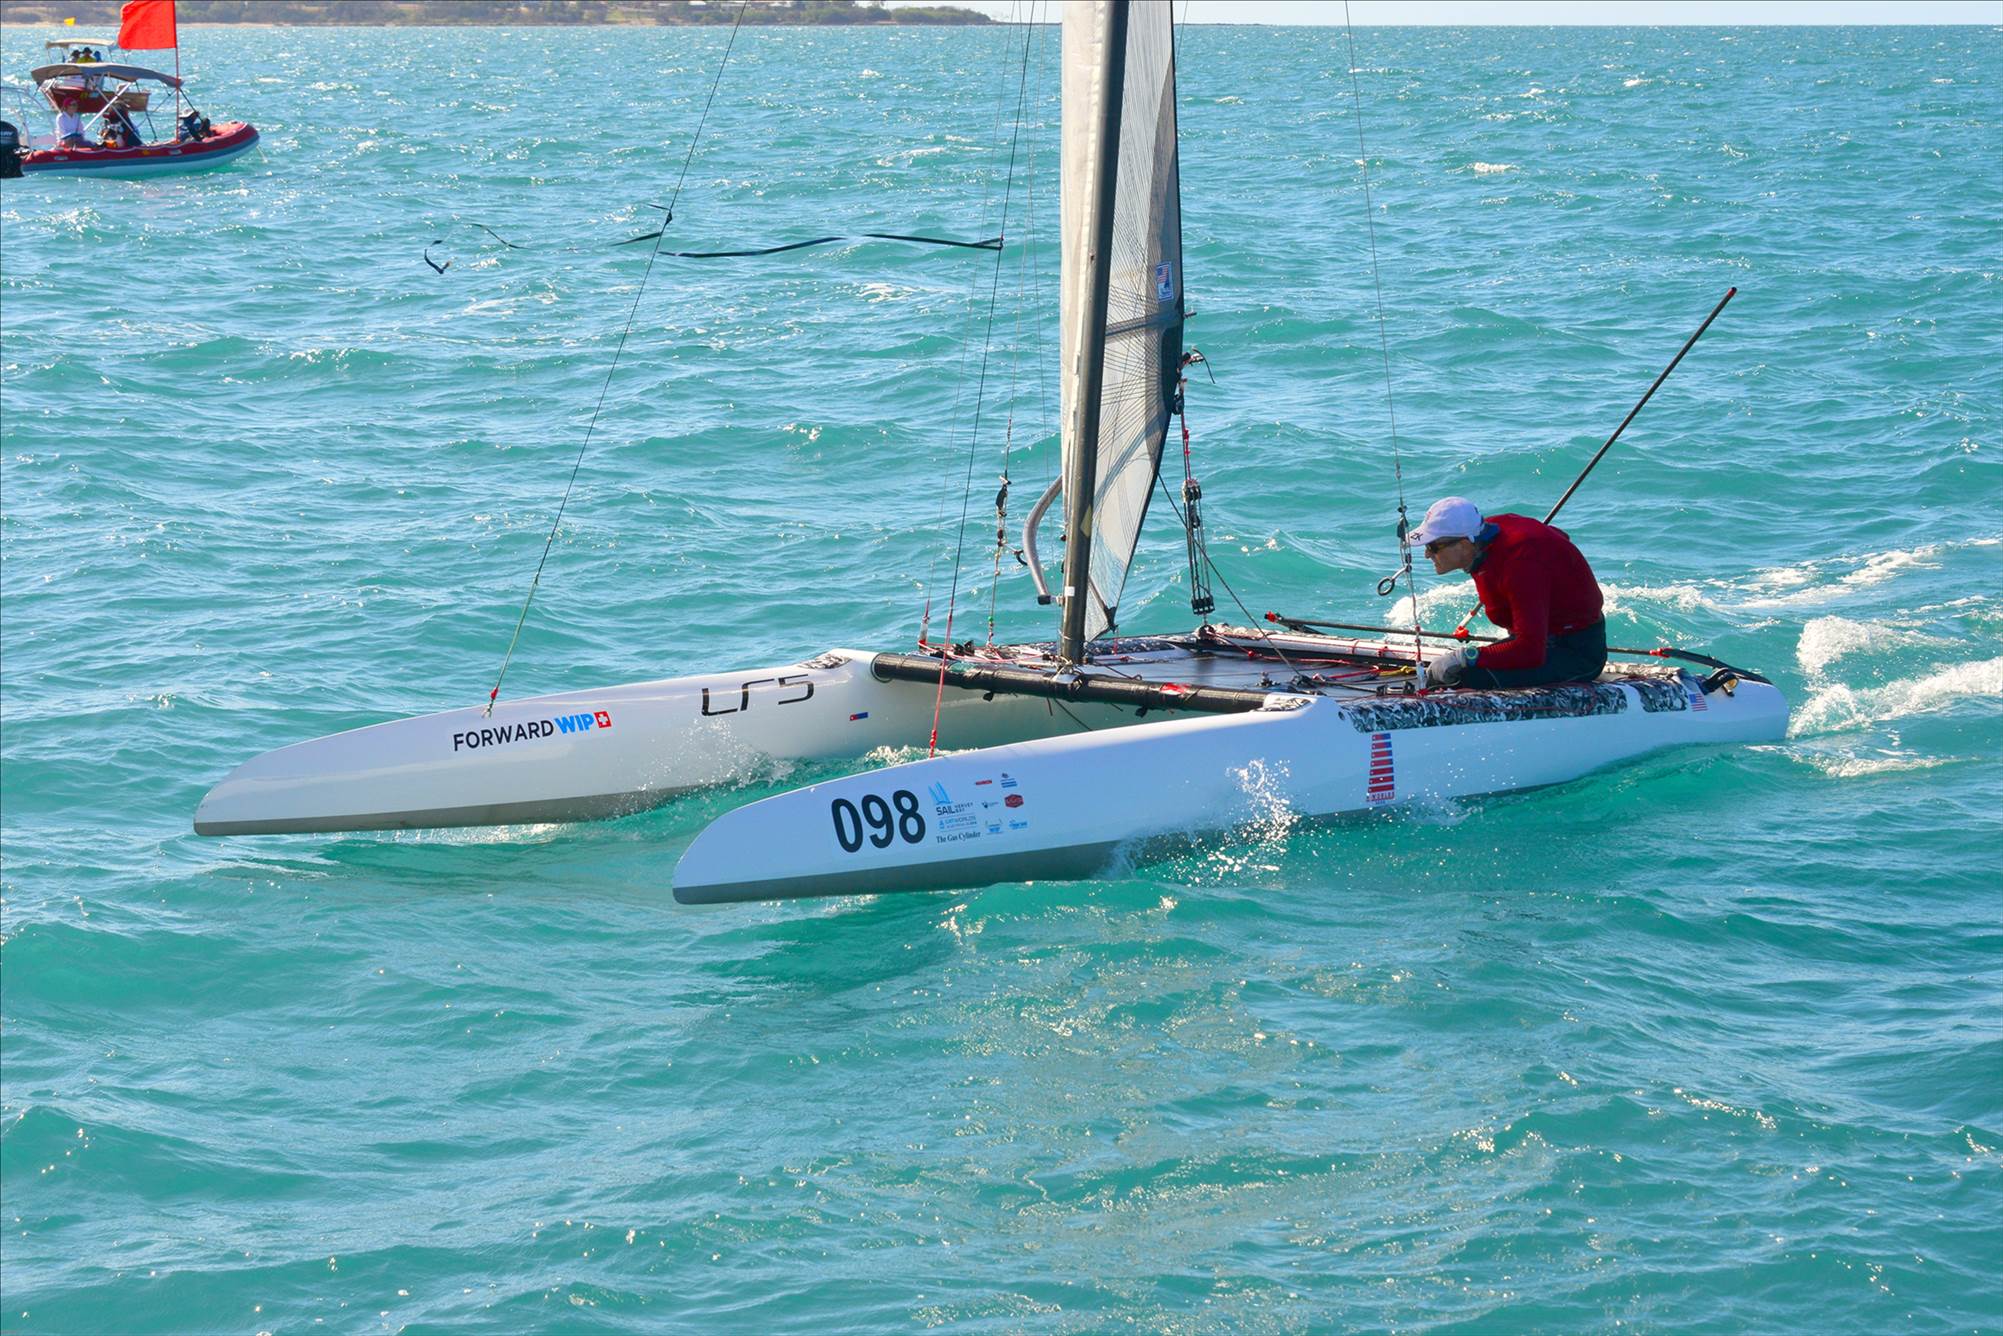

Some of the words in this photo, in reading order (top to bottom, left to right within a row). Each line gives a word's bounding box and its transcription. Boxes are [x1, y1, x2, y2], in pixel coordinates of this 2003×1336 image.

[936, 805, 956, 816] SAIL
[831, 789, 926, 853] 098
[936, 836, 947, 844] The
[947, 834, 959, 842] Gas
[959, 831, 982, 842] Cylinder
